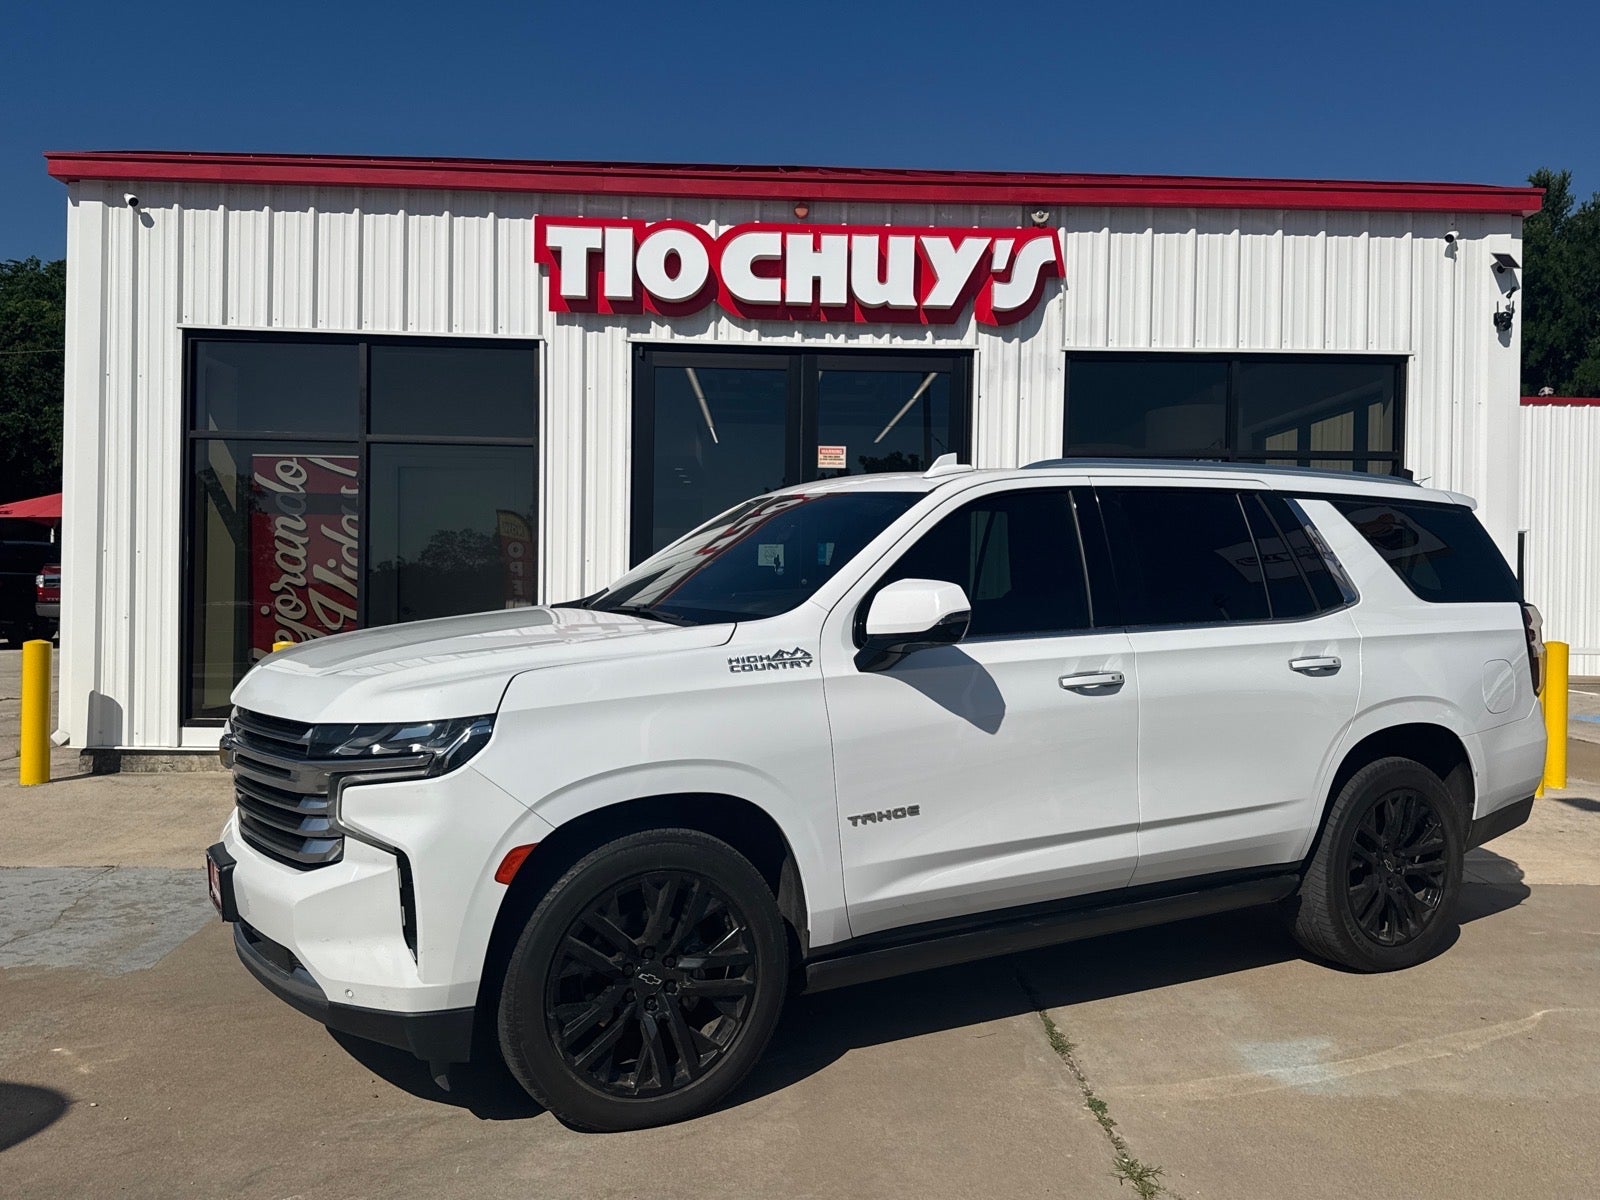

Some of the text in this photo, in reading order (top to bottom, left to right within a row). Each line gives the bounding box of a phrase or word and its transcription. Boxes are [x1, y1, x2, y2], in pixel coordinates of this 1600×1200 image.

[546, 224, 1056, 311] TIO CHUY'S
[253, 457, 325, 661] ejorando
[727, 654, 771, 665] HIGH
[729, 660, 813, 673] COUNTRY
[847, 804, 920, 827] TAHOE
